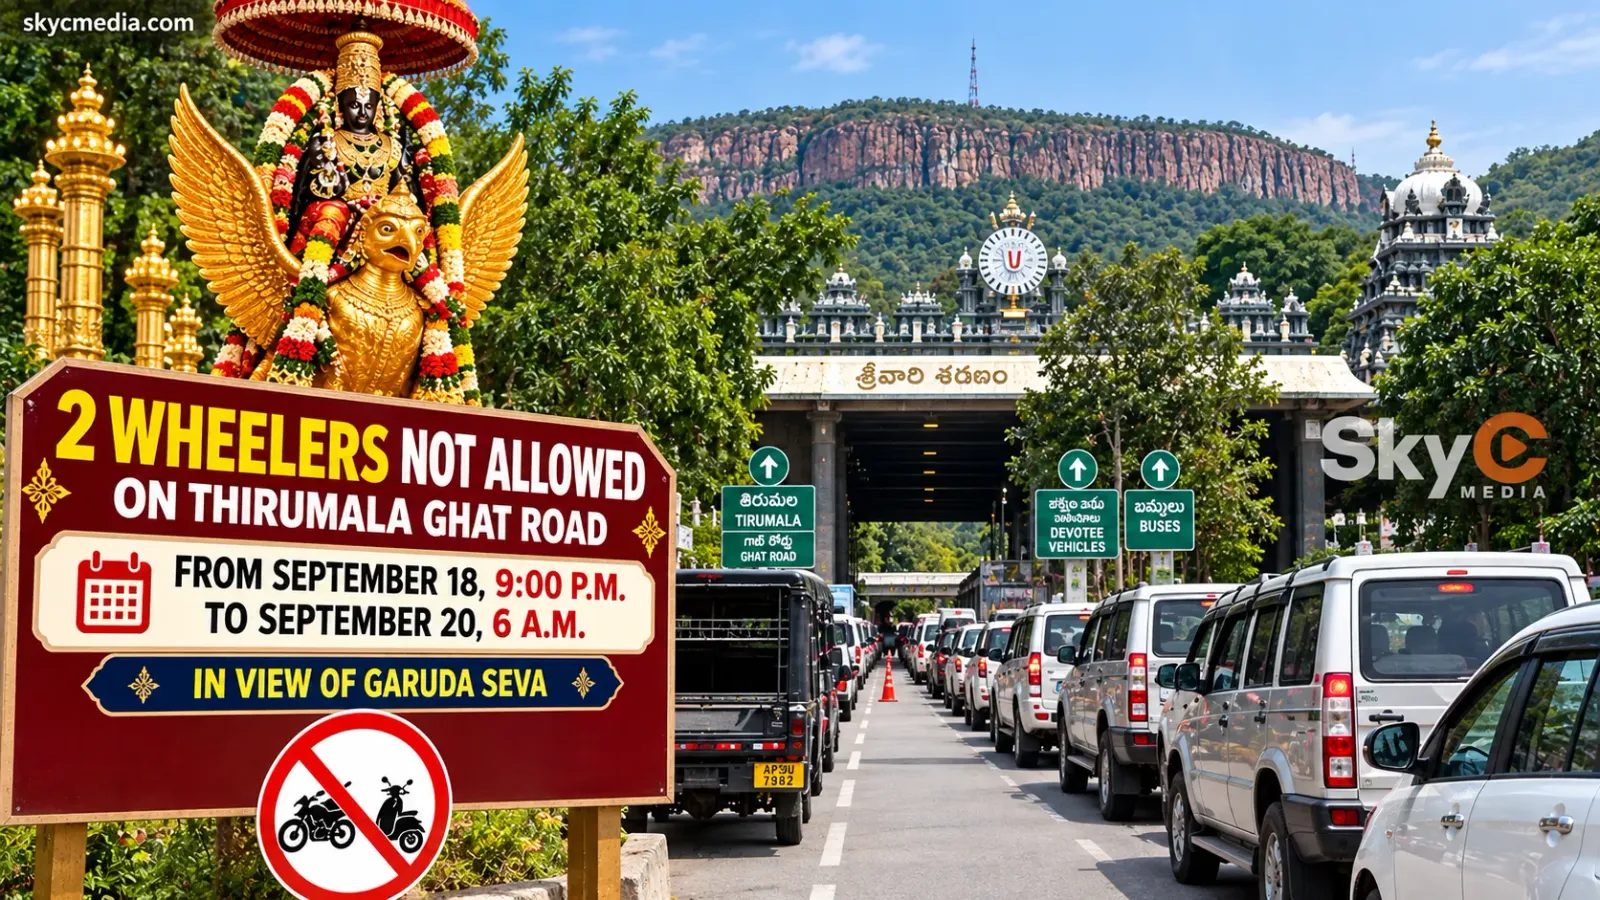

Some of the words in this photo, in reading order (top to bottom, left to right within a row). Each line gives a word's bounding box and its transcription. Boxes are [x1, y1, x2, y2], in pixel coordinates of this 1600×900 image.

[55, 389, 97, 462] 2
[109, 395, 390, 484] WHEELERS
[402, 427, 477, 488] NOT
[484, 437, 646, 501] ALLOWED
[113, 477, 177, 521] ON
[196, 481, 412, 536] THIRUMALA
[423, 499, 512, 543] GHAT
[521, 506, 608, 546] ROAD
[735, 514, 802, 527] TIRUMALA
[1140, 520, 1181, 533] BUSES
[1050, 527, 1104, 539] DEVOTEE
[1048, 541, 1106, 553] VEHICLES
[740, 551, 767, 562] GHAT
[769, 551, 797, 562] ROAD
[175, 554, 262, 591] FROM
[272, 558, 438, 597] SEPTEMBER
[447, 566, 485, 604] 18,
[495, 568, 562, 601] 9:00
[571, 571, 626, 603] P.M.
[204, 601, 248, 635] TO
[258, 603, 432, 638] SEPTEMBER
[440, 607, 483, 643] 20,
[492, 608, 512, 638] 6
[521, 609, 586, 640] A.M.
[194, 668, 226, 699] IN
[235, 668, 312, 698] VIEW
[320, 667, 357, 698] OF
[364, 667, 475, 698] GARUDA
[481, 668, 548, 697] SEVA
[763, 775, 794, 786] 7982
